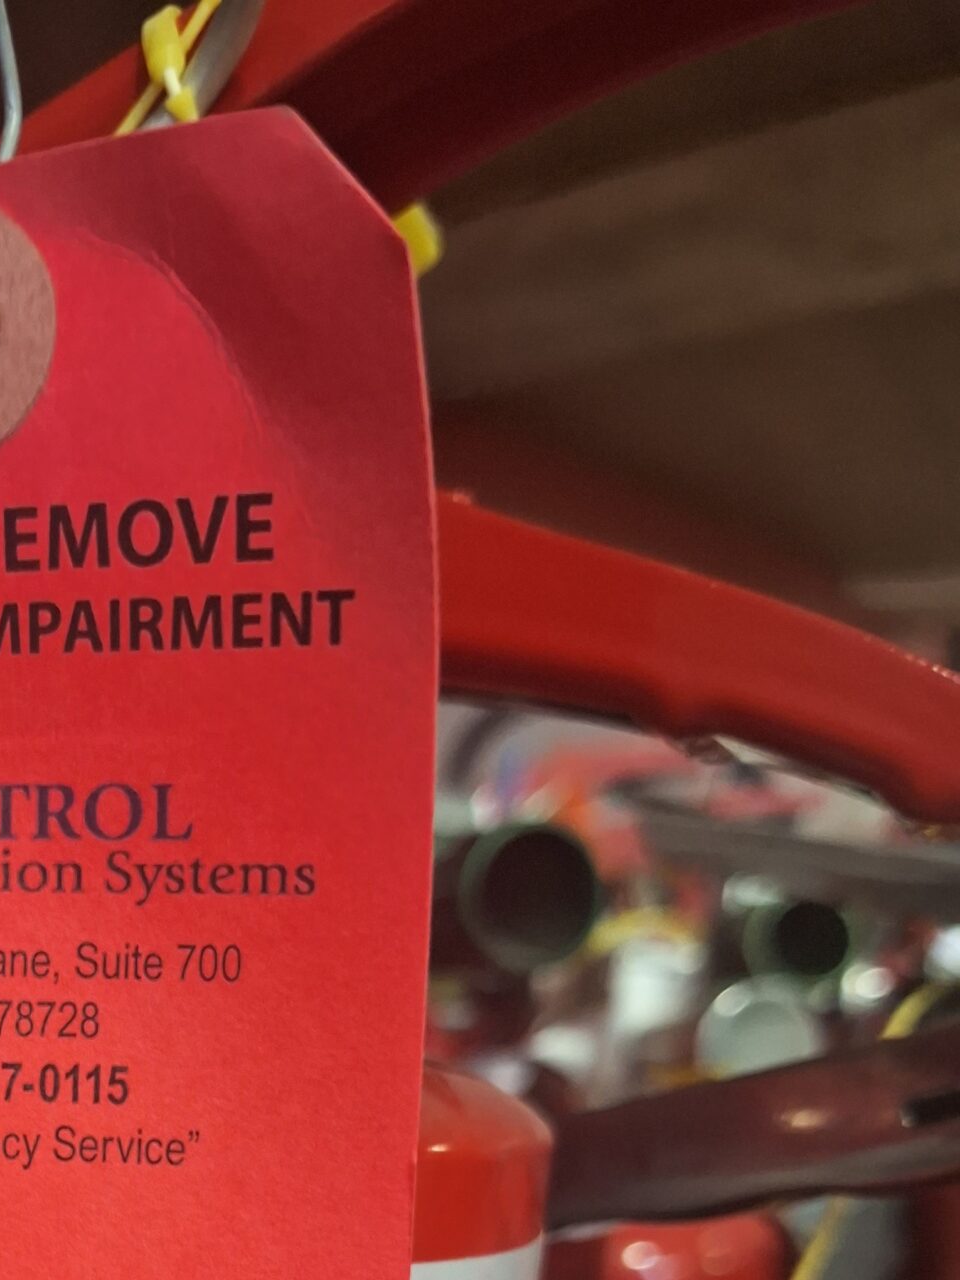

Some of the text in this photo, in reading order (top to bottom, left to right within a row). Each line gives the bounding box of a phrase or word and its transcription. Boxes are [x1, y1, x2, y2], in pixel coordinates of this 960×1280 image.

[105, 850, 316, 905] Systems
[74, 942, 164, 982] Suite
[178, 943, 242, 984] 700
